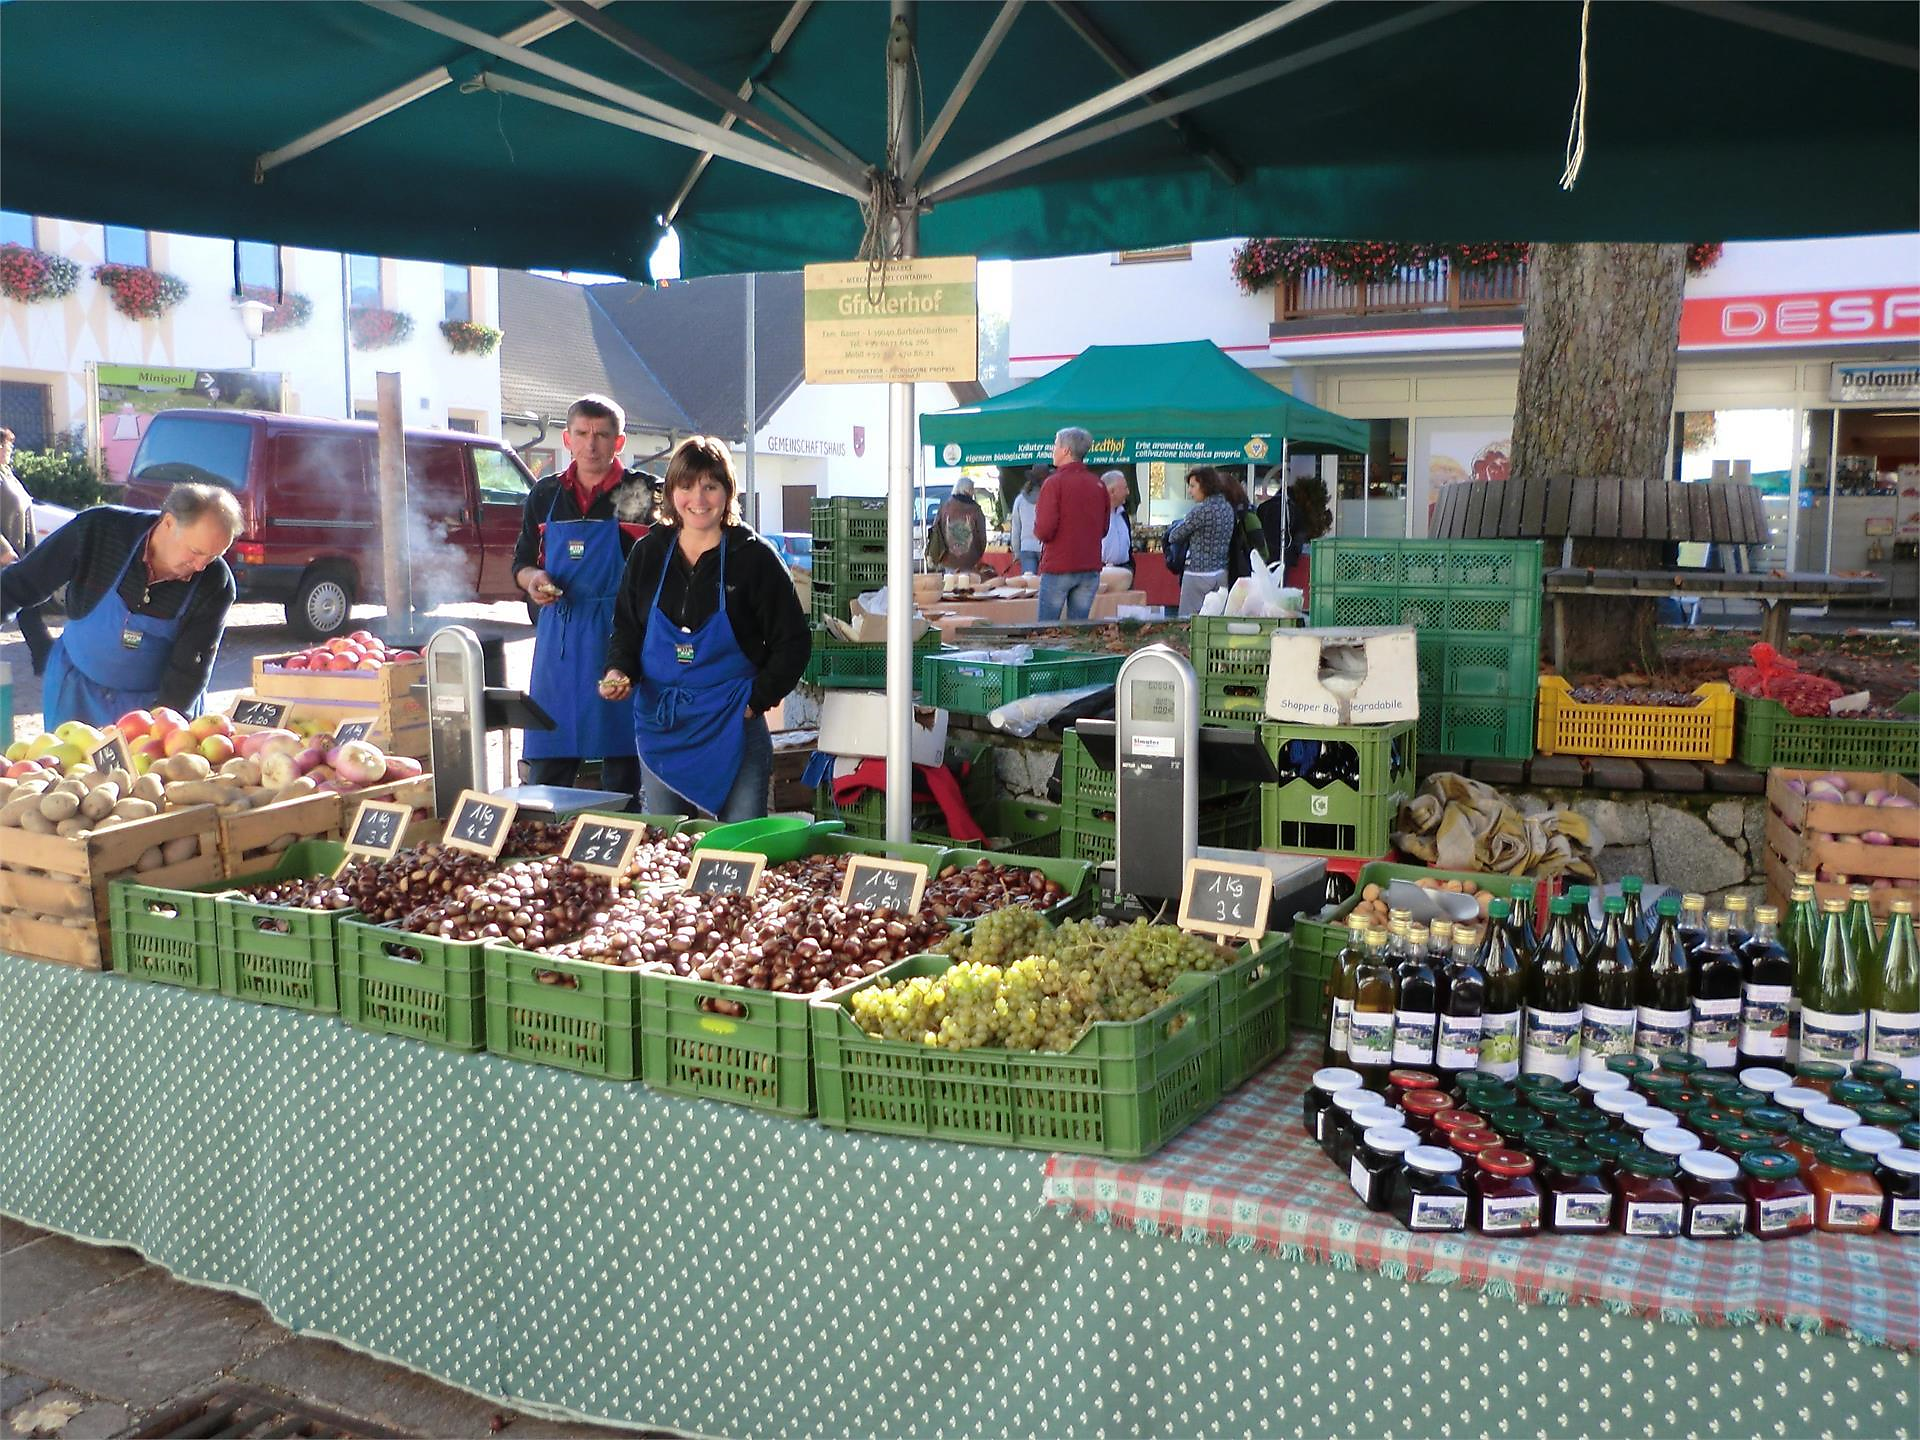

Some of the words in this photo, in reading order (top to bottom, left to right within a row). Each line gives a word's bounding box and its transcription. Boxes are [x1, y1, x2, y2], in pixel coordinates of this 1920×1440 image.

[138, 372, 186, 384] Minigolf
[768, 436, 846, 456] GEMEINSCHAFTSHAUS
[1018, 443, 1044, 452] Kräuter
[1088, 438, 1126, 456] iedthof
[1135, 441, 1150, 450] Erbe
[1152, 441, 1193, 450] aromatiche
[1195, 441, 1205, 450] da
[965, 454, 992, 462] eigenem
[994, 451, 1033, 462] biologischen
[1135, 450, 1177, 458] coltivazione
[1178, 449, 1212, 459] biologica
[1213, 449, 1241, 459] propria
[1281, 699, 1320, 713] Shopper
[365, 830, 377, 844] 3
[466, 824, 475, 838] 4
[590, 827, 604, 841] 1
[584, 845, 599, 860] 5
[865, 869, 882, 886] 1
[1208, 875, 1221, 893] 1
[1216, 900, 1226, 921] 3
[1231, 903, 1242, 919] €
